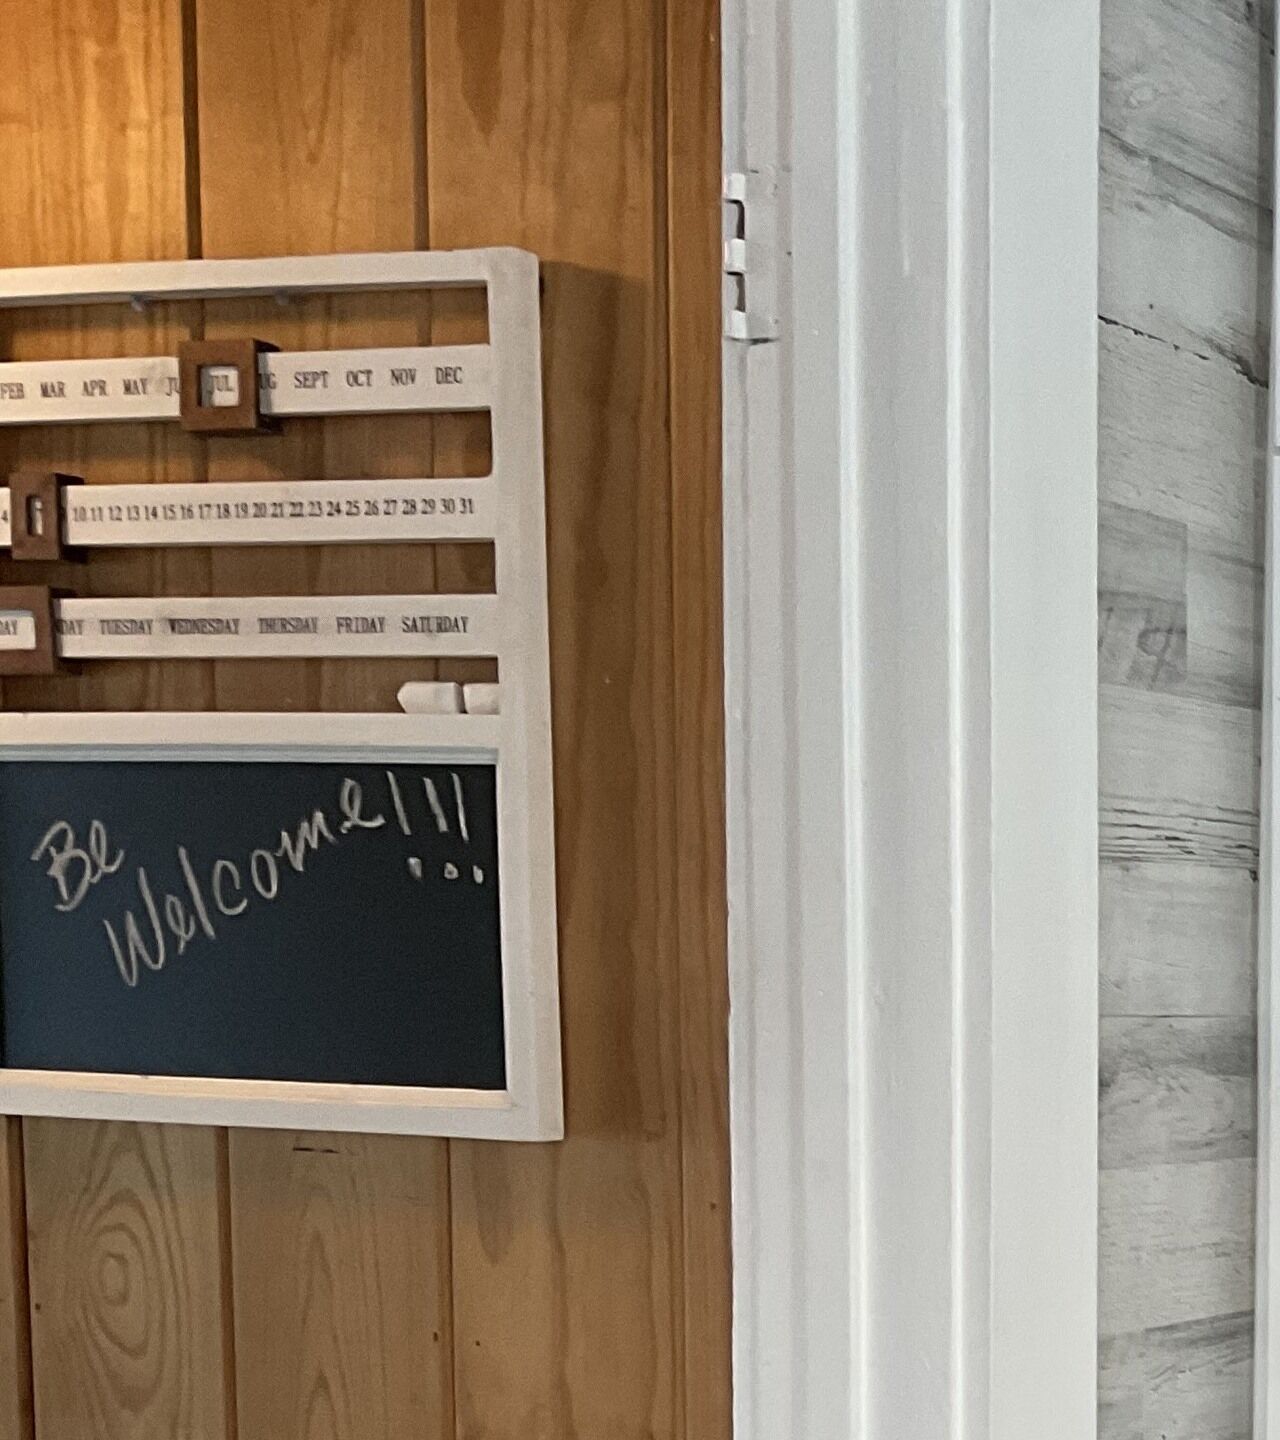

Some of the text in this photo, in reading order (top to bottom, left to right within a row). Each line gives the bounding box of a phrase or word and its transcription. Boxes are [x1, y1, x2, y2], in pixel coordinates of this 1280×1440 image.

[40, 381, 65, 398] MAR
[82, 380, 108, 396] APR
[123, 378, 147, 395] MAY
[206, 374, 234, 394] JUL
[294, 370, 329, 388] SEPT
[346, 369, 373, 386] OCT
[390, 369, 416, 385] NOV
[435, 367, 463, 384] DEC
[73, 507, 86, 521] 10
[91, 507, 103, 521] 11
[108, 506, 122, 521] 12
[127, 505, 140, 520] 13
[144, 506, 158, 520] 14
[163, 505, 176, 520] 15
[180, 505, 193, 519] 16
[198, 504, 211, 519] 17
[217, 504, 230, 518] 18
[235, 503, 248, 518] 19
[253, 503, 267, 518] 20
[271, 503, 284, 518] 21
[290, 502, 304, 517] 22
[308, 501, 322, 516] 23
[327, 500, 341, 516] 24
[346, 500, 359, 515] 25
[364, 500, 379, 515] 26
[383, 500, 397, 515] 27
[402, 499, 416, 514] 28
[421, 499, 435, 514] 29
[440, 498, 455, 513] 30
[460, 498, 474, 513] 31
[100, 619, 153, 635] TUESDAY
[168, 618, 240, 635] WEDNESDAY
[258, 617, 318, 634] THURSDAY
[336, 617, 385, 634] FRIDAY
[402, 616, 469, 633] SATURDAY
[30, 818, 126, 913] Be
[103, 770, 485, 988] Welcome!!!
